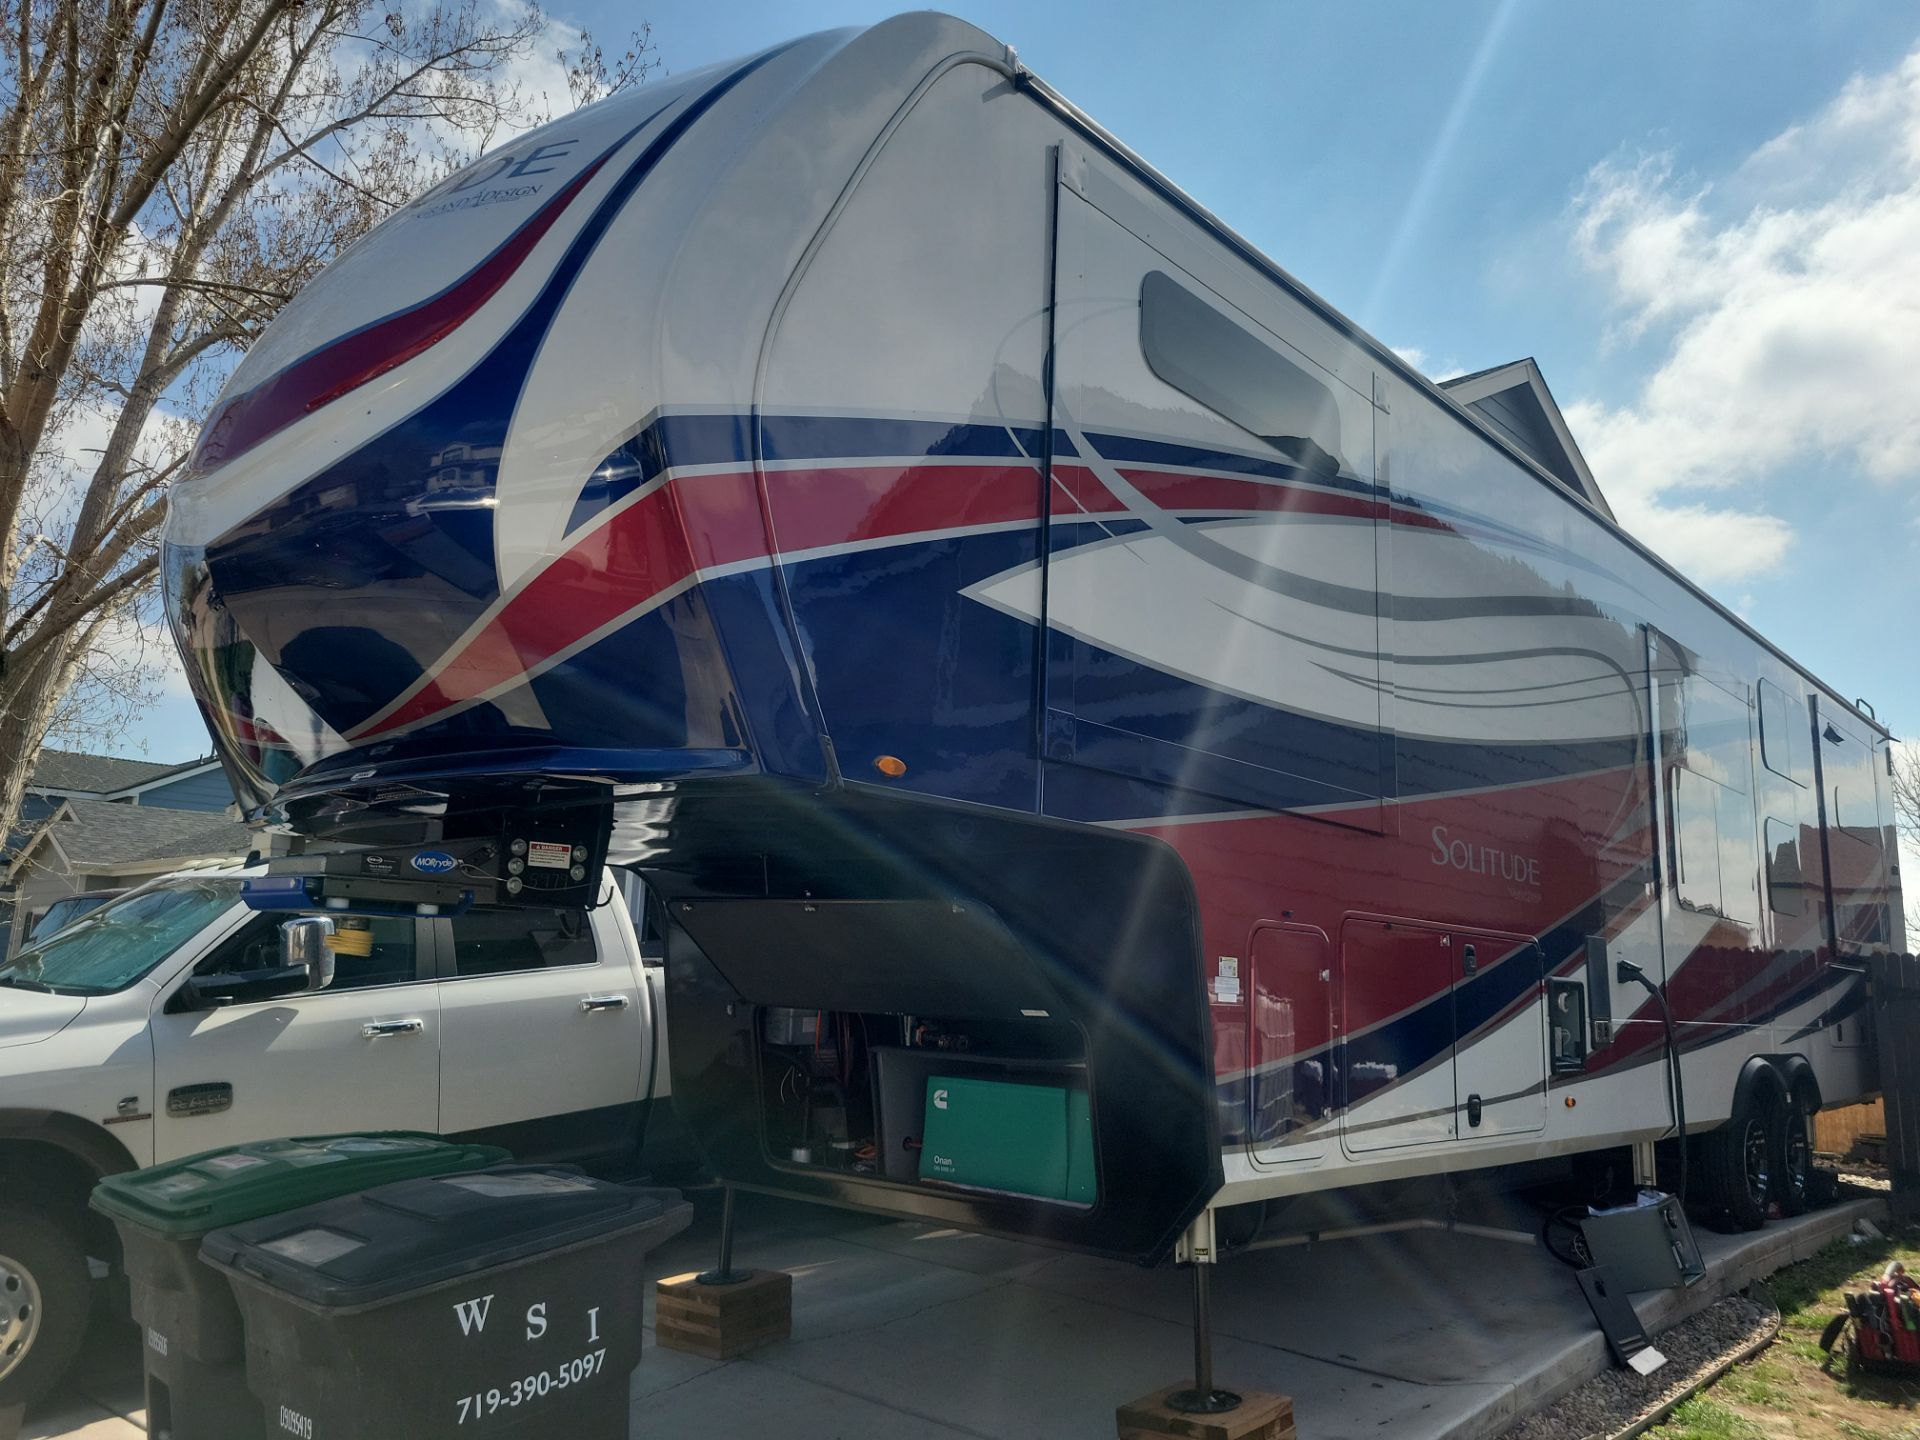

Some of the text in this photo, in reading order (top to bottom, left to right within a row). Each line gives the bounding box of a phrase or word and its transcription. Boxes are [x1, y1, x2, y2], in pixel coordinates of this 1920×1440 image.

[1431, 825, 1540, 886] SOLITUDE
[933, 1155, 953, 1166] Onan
[453, 1294, 600, 1342] W S I
[456, 1348, 607, 1424] 719-390-5097
